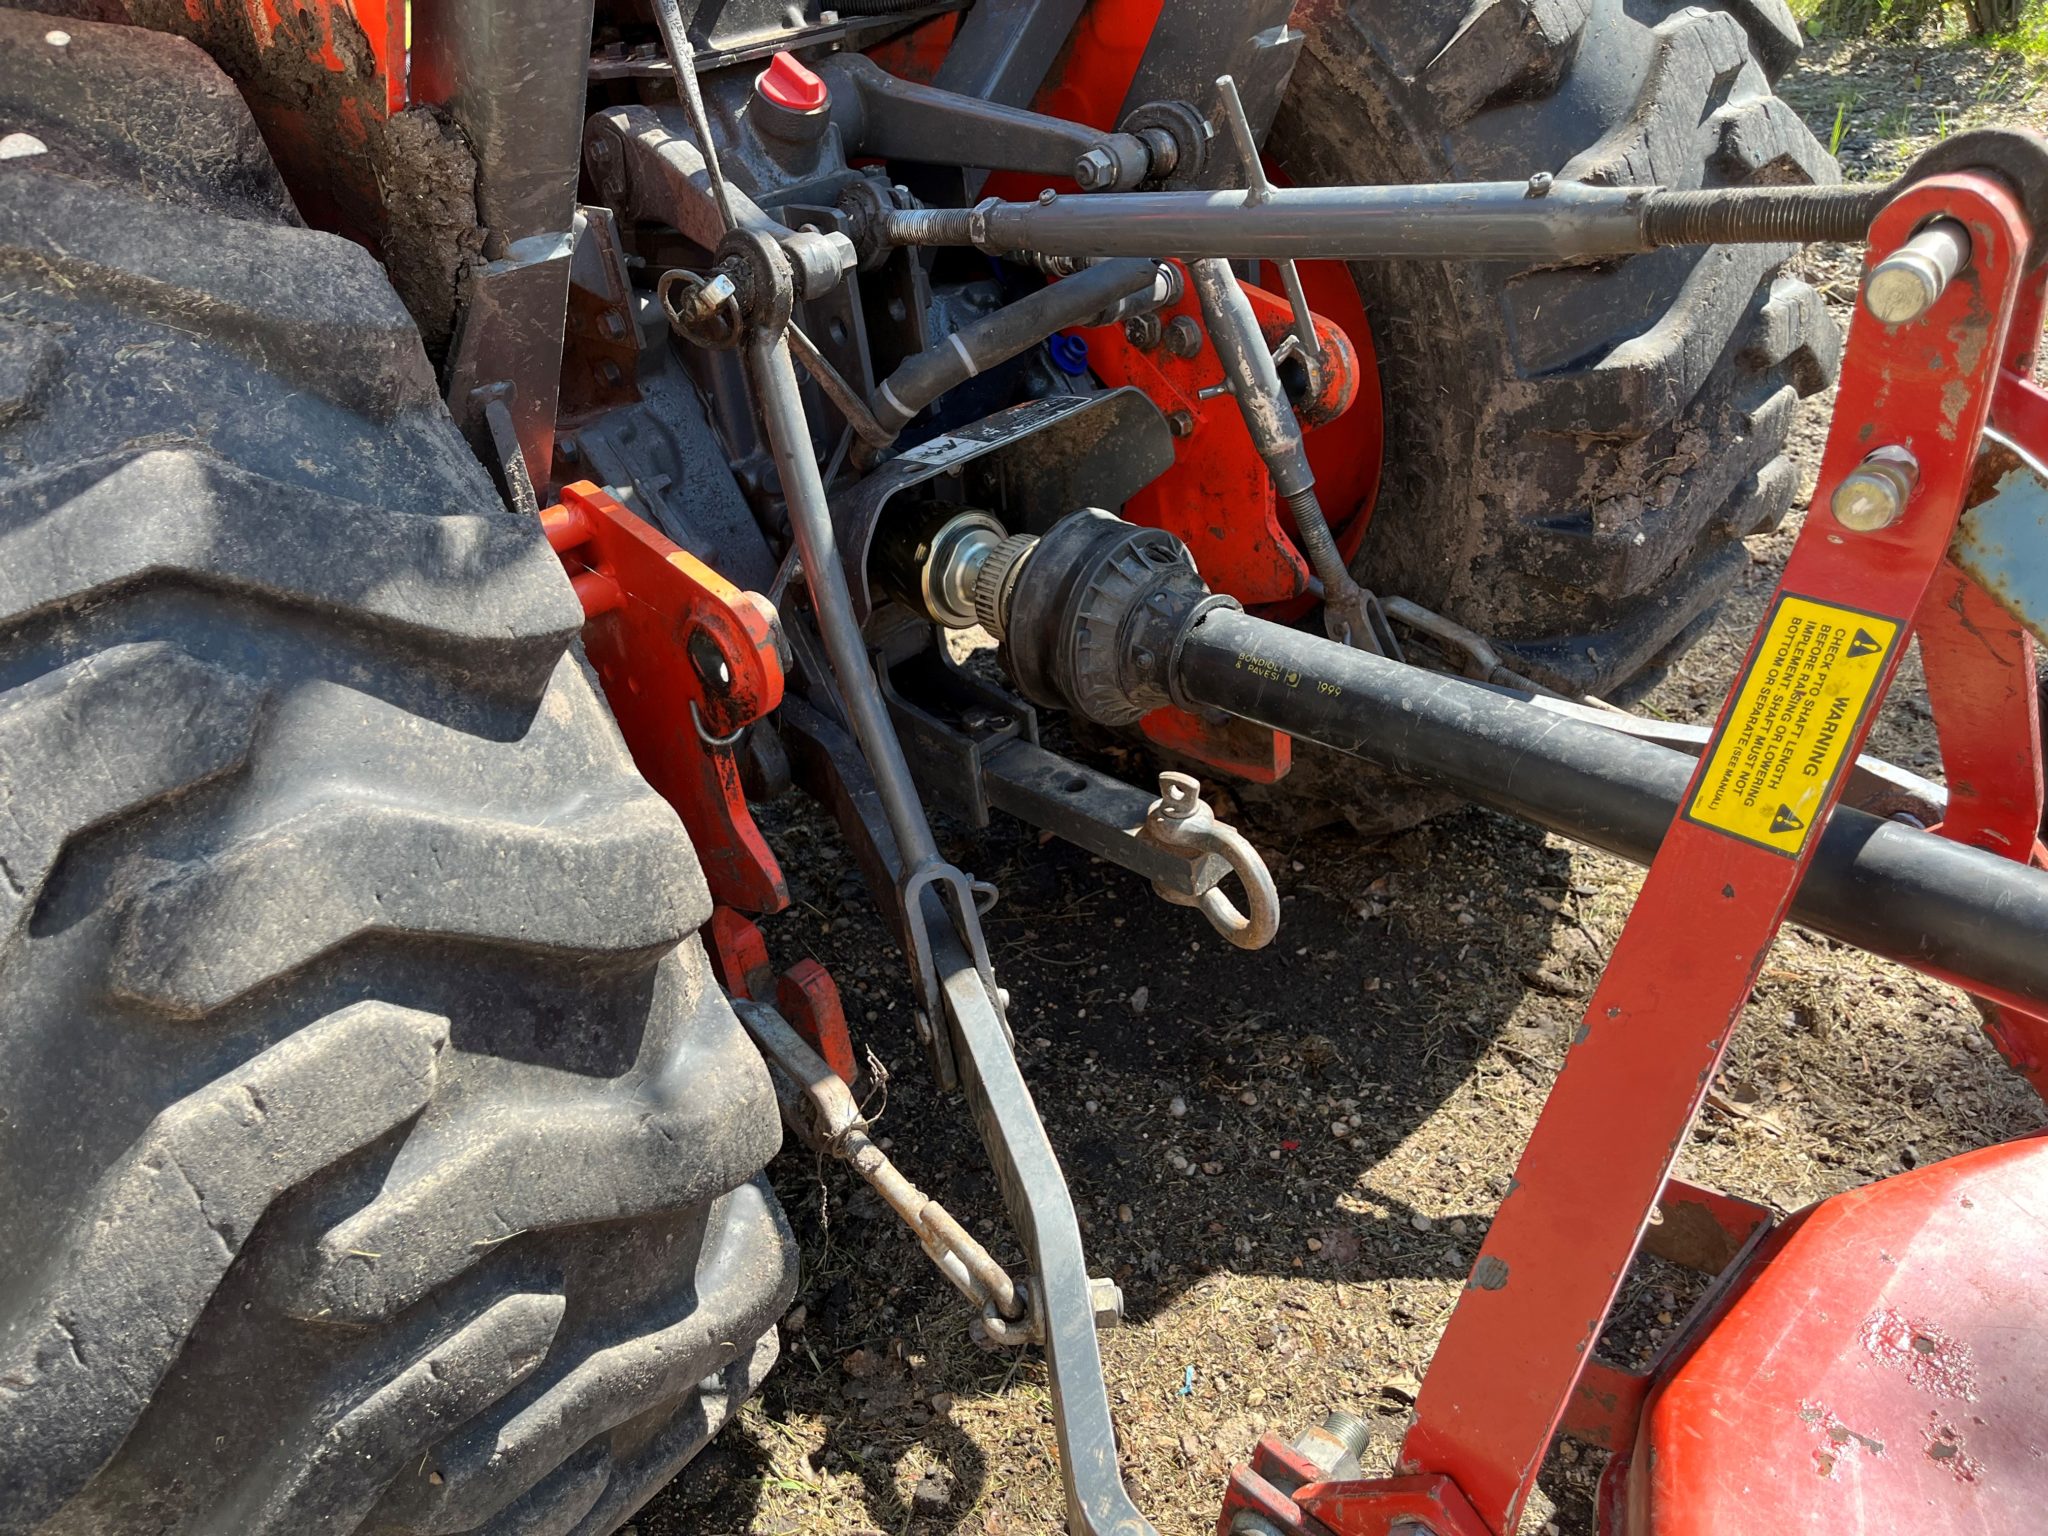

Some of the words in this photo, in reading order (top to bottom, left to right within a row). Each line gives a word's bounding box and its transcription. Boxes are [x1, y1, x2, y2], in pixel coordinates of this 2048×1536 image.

[1239, 652, 1284, 673] BONDIOLI
[1772, 617, 1803, 668] BOTTOM
[1777, 620, 1817, 690] IMPLEMENT.
[1803, 624, 1832, 671] BEFORE
[1820, 628, 1846, 671] CHECK
[1235, 660, 1242, 669] &
[1247, 664, 1280, 681] PAVESI
[1316, 680, 1342, 697] 1999
[1764, 668, 1779, 686] OR
[1809, 672, 1828, 697] PTO
[1737, 687, 1771, 747] SEPARATE
[1760, 694, 1784, 734] SHAFT
[1780, 673, 1810, 722] RAISING
[1771, 725, 1787, 743] OR
[1790, 699, 1815, 739] SHAFT
[1802, 697, 1850, 777] WARNING
[1728, 746, 1743, 768] (SEE
[1744, 735, 1767, 770] MUST
[1767, 740, 1797, 790] LENGTH
[1708, 768, 1734, 810] MANUAL)
[1733, 770, 1751, 797] NOT
[1743, 744, 1779, 807] LOWERING
